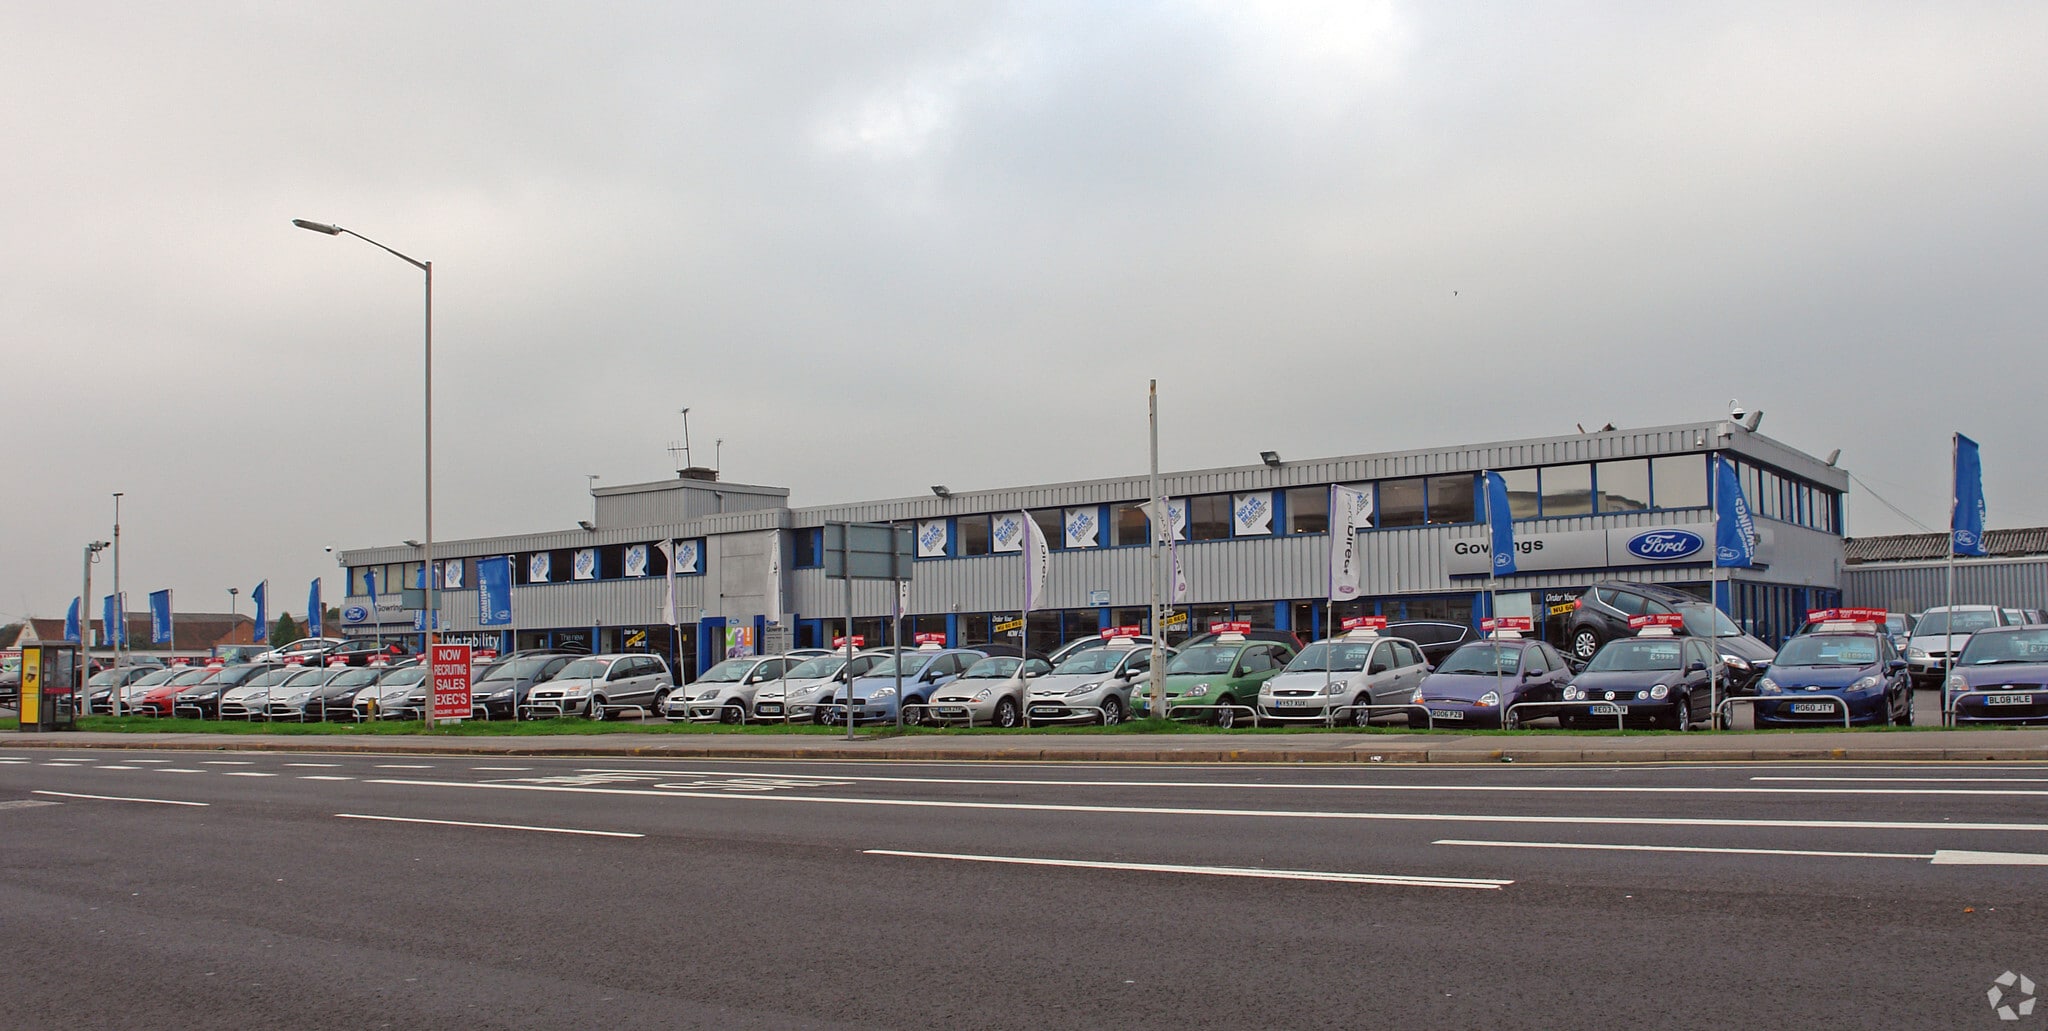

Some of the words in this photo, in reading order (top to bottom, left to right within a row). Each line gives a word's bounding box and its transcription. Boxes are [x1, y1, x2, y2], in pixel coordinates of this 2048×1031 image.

[1641, 534, 1688, 554] Ford
[378, 604, 403, 612] owring
[438, 649, 461, 661] NOW
[433, 664, 467, 676] RECRUITING
[436, 678, 466, 691] SALES
[434, 693, 468, 705] EXEC'S
[2013, 695, 2031, 703] HLE
